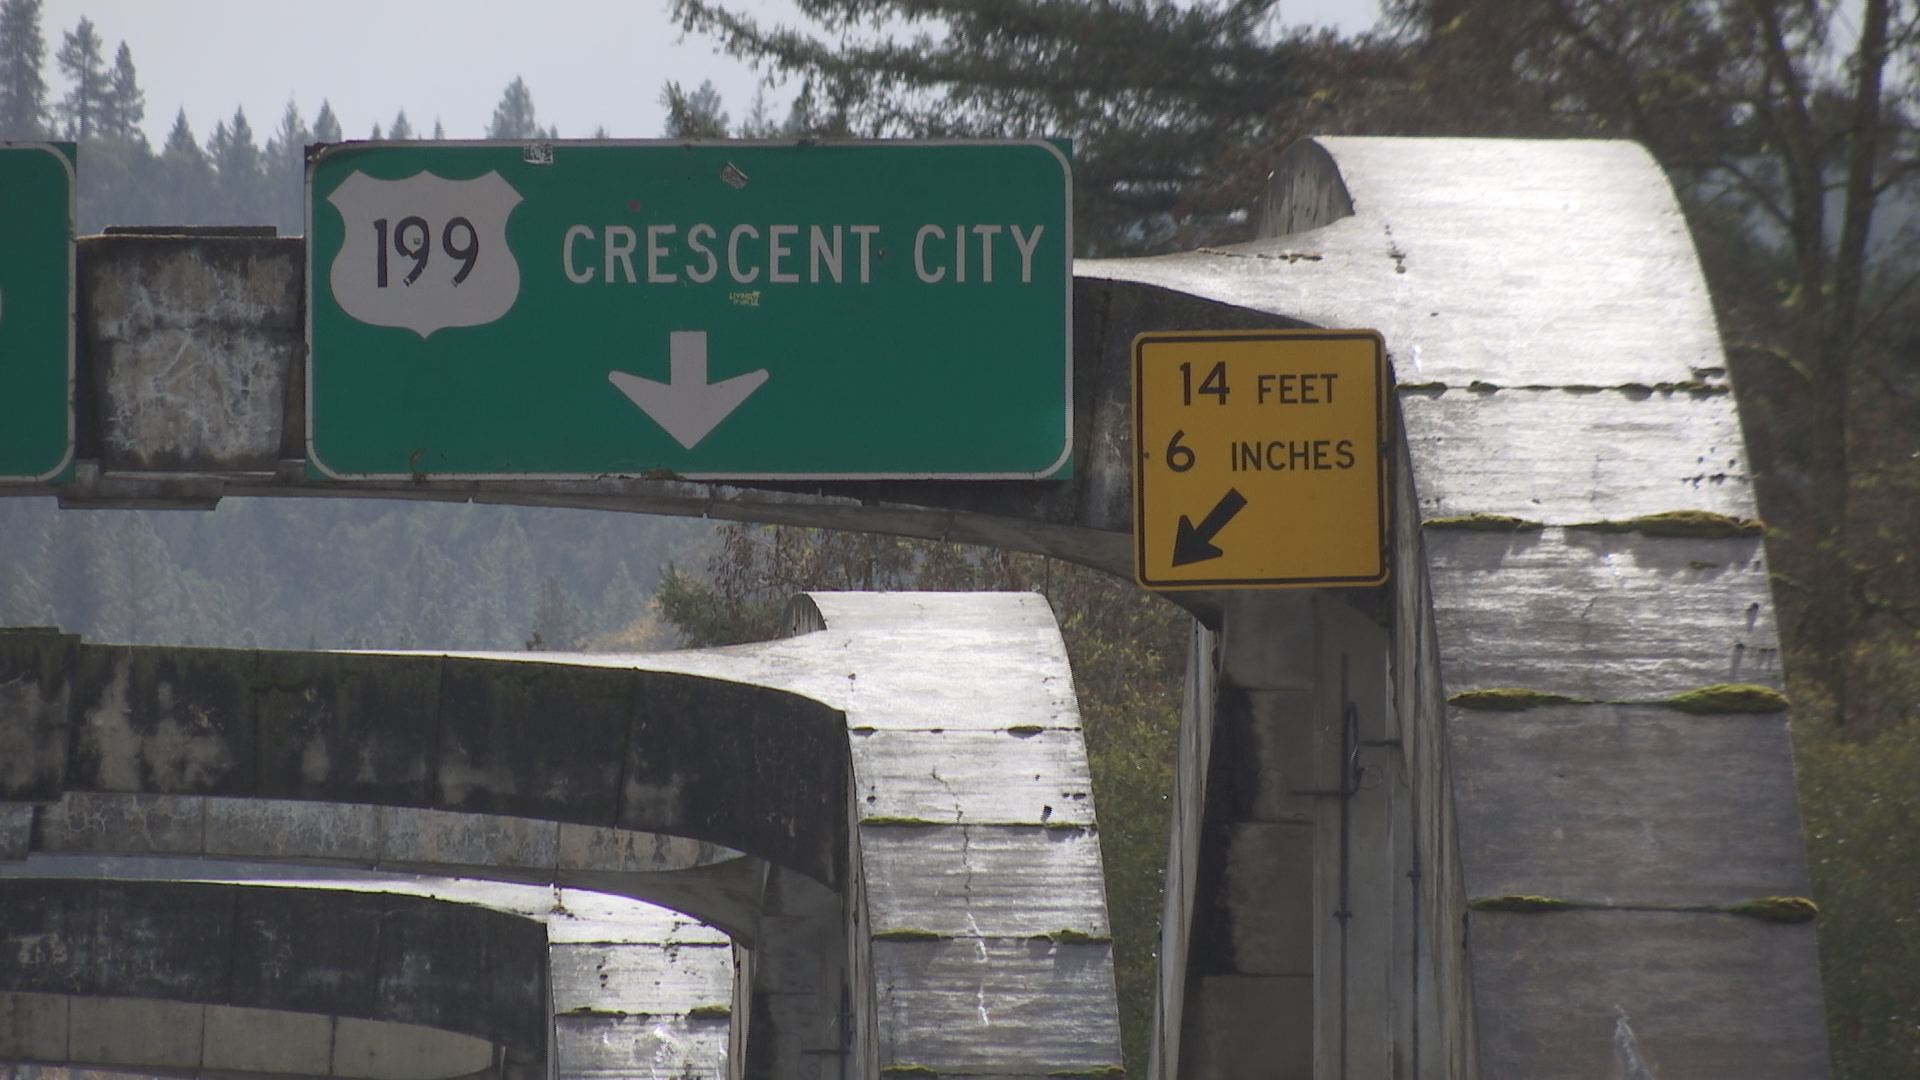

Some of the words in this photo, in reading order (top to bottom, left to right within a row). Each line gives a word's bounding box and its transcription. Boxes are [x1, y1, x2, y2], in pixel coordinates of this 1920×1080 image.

[373, 216, 479, 288] 199
[564, 224, 880, 284] CRESCENT
[914, 224, 1045, 284] CITY
[1179, 361, 1231, 406] 14
[1257, 373, 1338, 405] FEET
[1166, 429, 1196, 473] 6
[1231, 440, 1355, 472] INCHES
